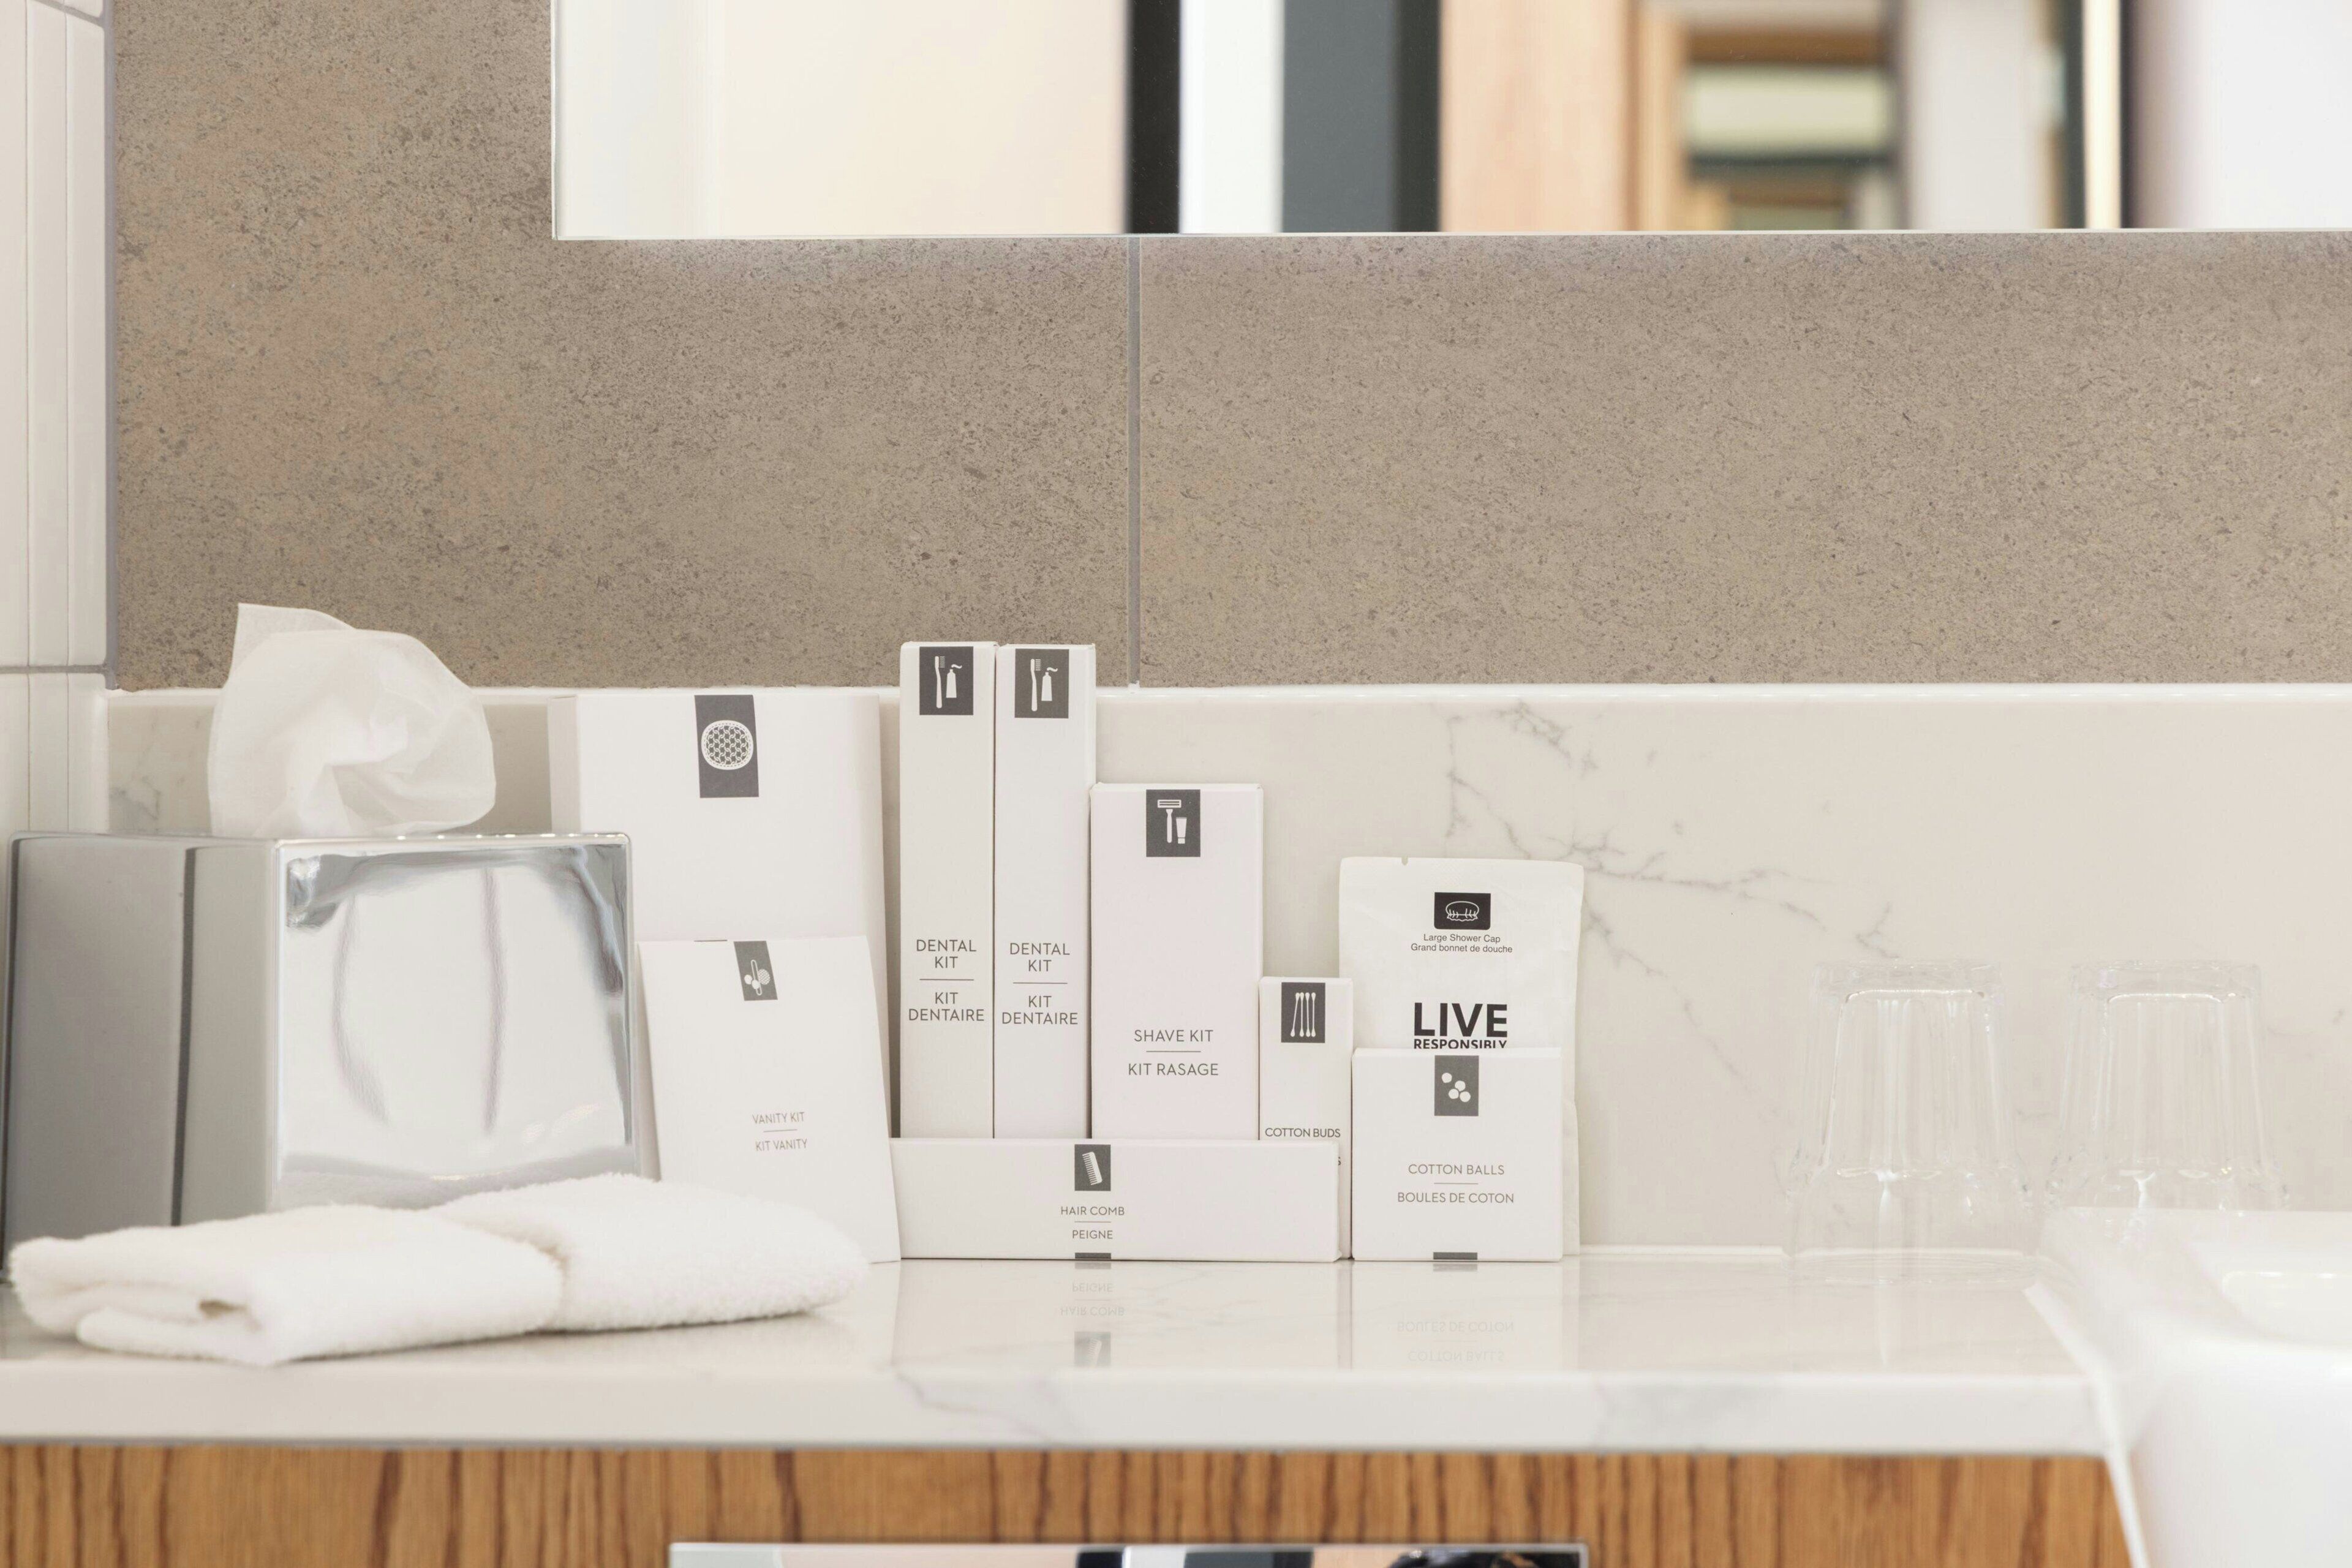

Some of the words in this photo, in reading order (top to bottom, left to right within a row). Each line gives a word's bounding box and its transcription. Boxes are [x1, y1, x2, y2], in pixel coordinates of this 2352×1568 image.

[1424, 933, 1447, 943] Large
[1450, 933, 1482, 942] Shower
[1484, 934, 1501, 944] Cap
[917, 940, 976, 952] DENTAL
[1011, 943, 1070, 955] DENTAL
[1411, 943, 1437, 952] Grand
[1439, 943, 1468, 952] bonnet
[1470, 944, 1480, 952] de
[1483, 944, 1513, 953] douche
[935, 956, 958, 968] KIT
[1029, 960, 1052, 971] KIT
[935, 992, 958, 1004] KIT
[1029, 996, 1052, 1008] KIT
[909, 1009, 984, 1021] DENTAIRE
[1003, 1012, 1077, 1025] DENTAIRE
[1414, 1003, 1507, 1037] LIVE
[1134, 1030, 1184, 1042] SHAVE
[1190, 1030, 1213, 1041] KIT
[1414, 1039, 1507, 1049] RESPONSIBLY
[1129, 1063, 1152, 1075] KIT
[1158, 1063, 1218, 1076] RASAGE
[752, 1113, 787, 1124] VANITY
[790, 1112, 804, 1121] KIT
[1265, 1128, 1310, 1137] COTTON
[1313, 1128, 1340, 1137] BUDS
[756, 1141, 771, 1151] KIT
[774, 1139, 807, 1150] VANITY
[1409, 1164, 1462, 1174] COTTON
[1467, 1165, 1504, 1175] BALLS
[1398, 1193, 1446, 1202] BOULES
[1450, 1193, 1464, 1202] DE
[1469, 1193, 1513, 1203] COTON
[1061, 1207, 1087, 1215] HAIR
[1090, 1207, 1125, 1215] COMB
[1072, 1230, 1112, 1239] PEIGNE
